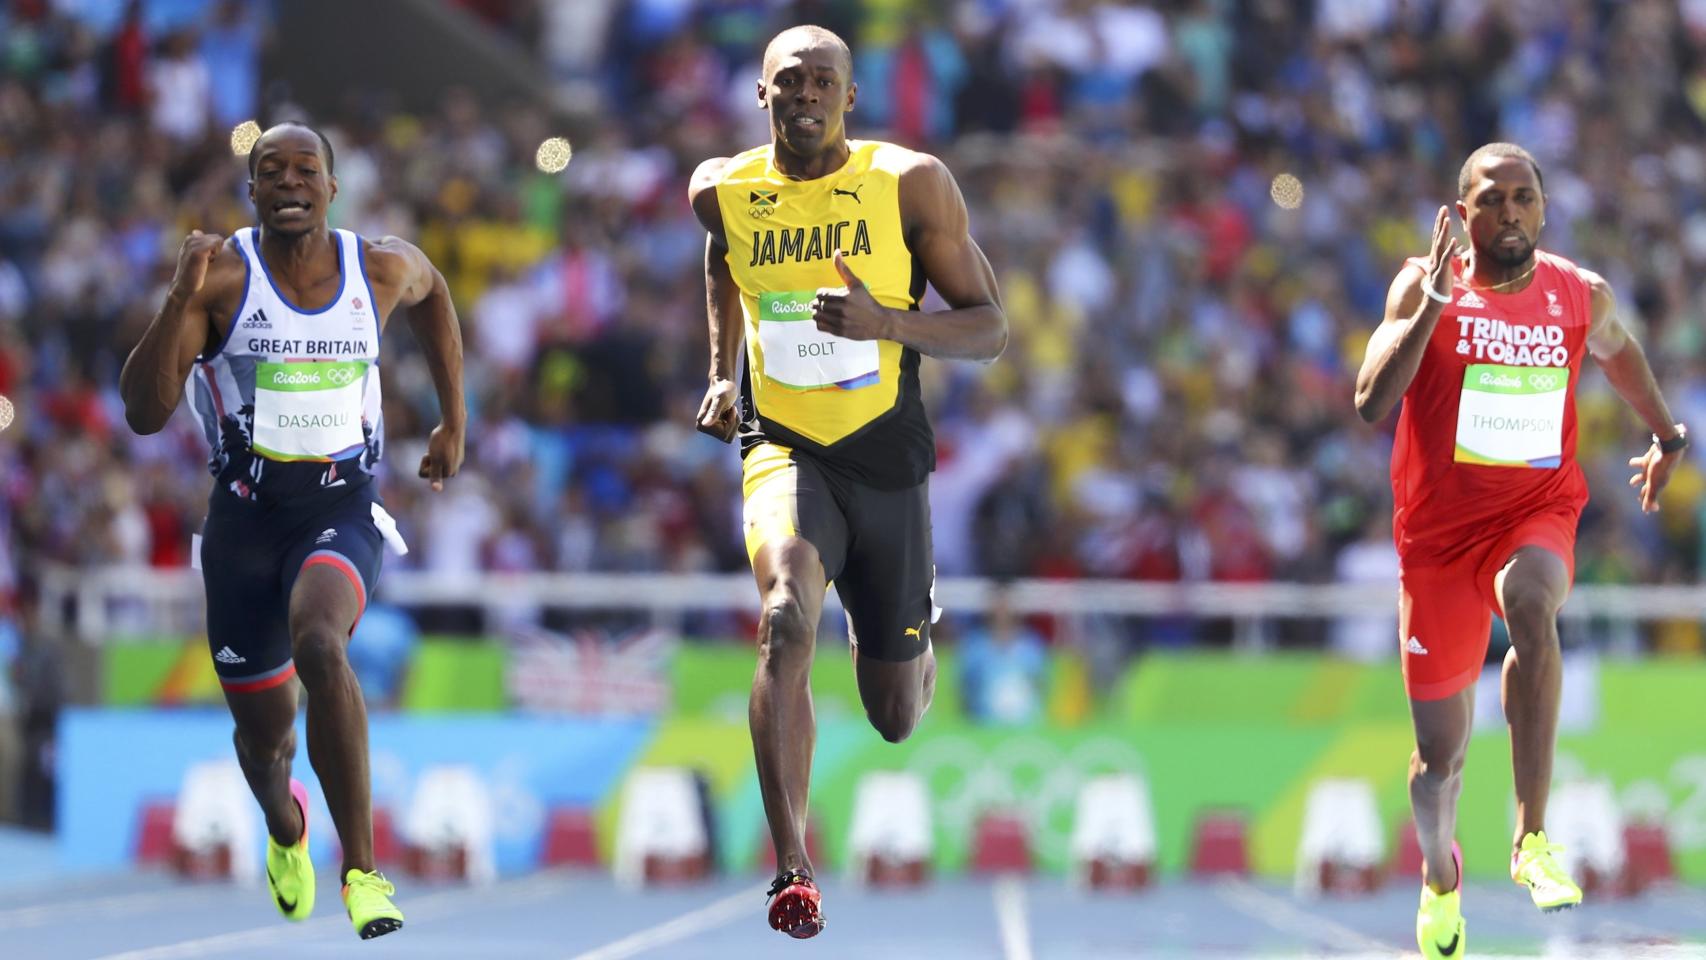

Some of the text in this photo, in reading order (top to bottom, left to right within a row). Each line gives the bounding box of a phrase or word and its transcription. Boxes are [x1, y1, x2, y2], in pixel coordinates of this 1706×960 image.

[750, 219, 872, 267] JAMAICA
[242, 321, 273, 329] adidas
[248, 338, 368, 354] GREAT BRITAIN
[797, 341, 836, 358] BOLT
[273, 371, 321, 385] Rio2016
[278, 414, 348, 428] DASAOLU
[1471, 414, 1555, 432] THOMPSON
